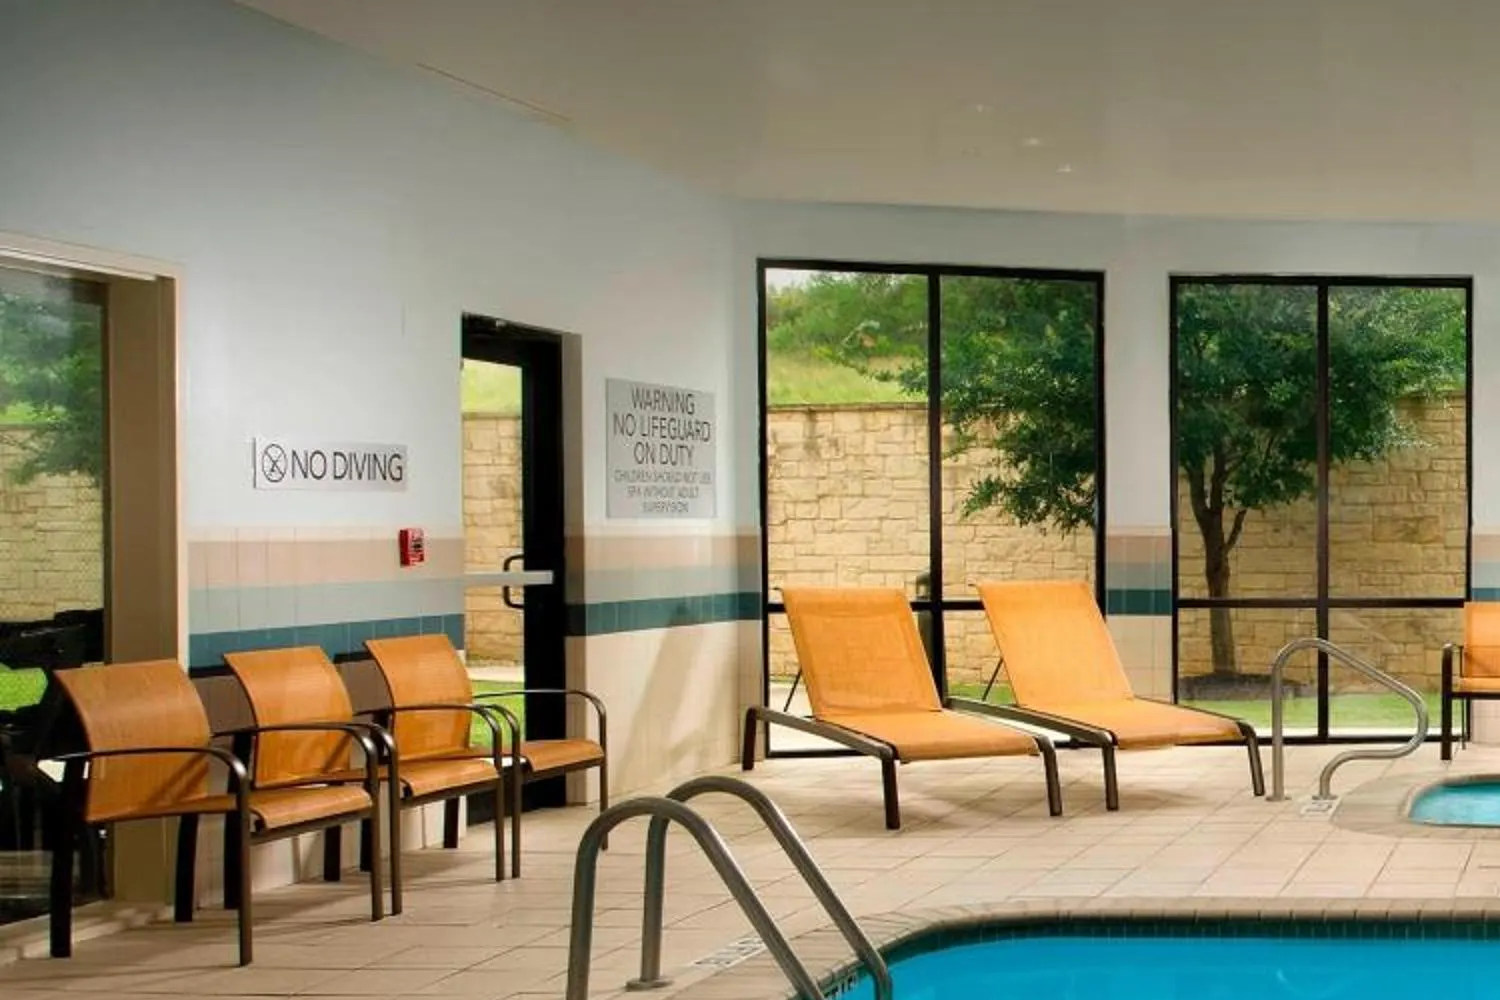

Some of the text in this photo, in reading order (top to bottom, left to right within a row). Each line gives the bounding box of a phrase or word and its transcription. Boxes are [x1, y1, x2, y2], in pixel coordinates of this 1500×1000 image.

[631, 387, 696, 415] WARNING
[612, 412, 711, 443] NO LIFEGUARD
[291, 449, 404, 482] NO DIVING
[633, 441, 694, 467] ON DUTY
